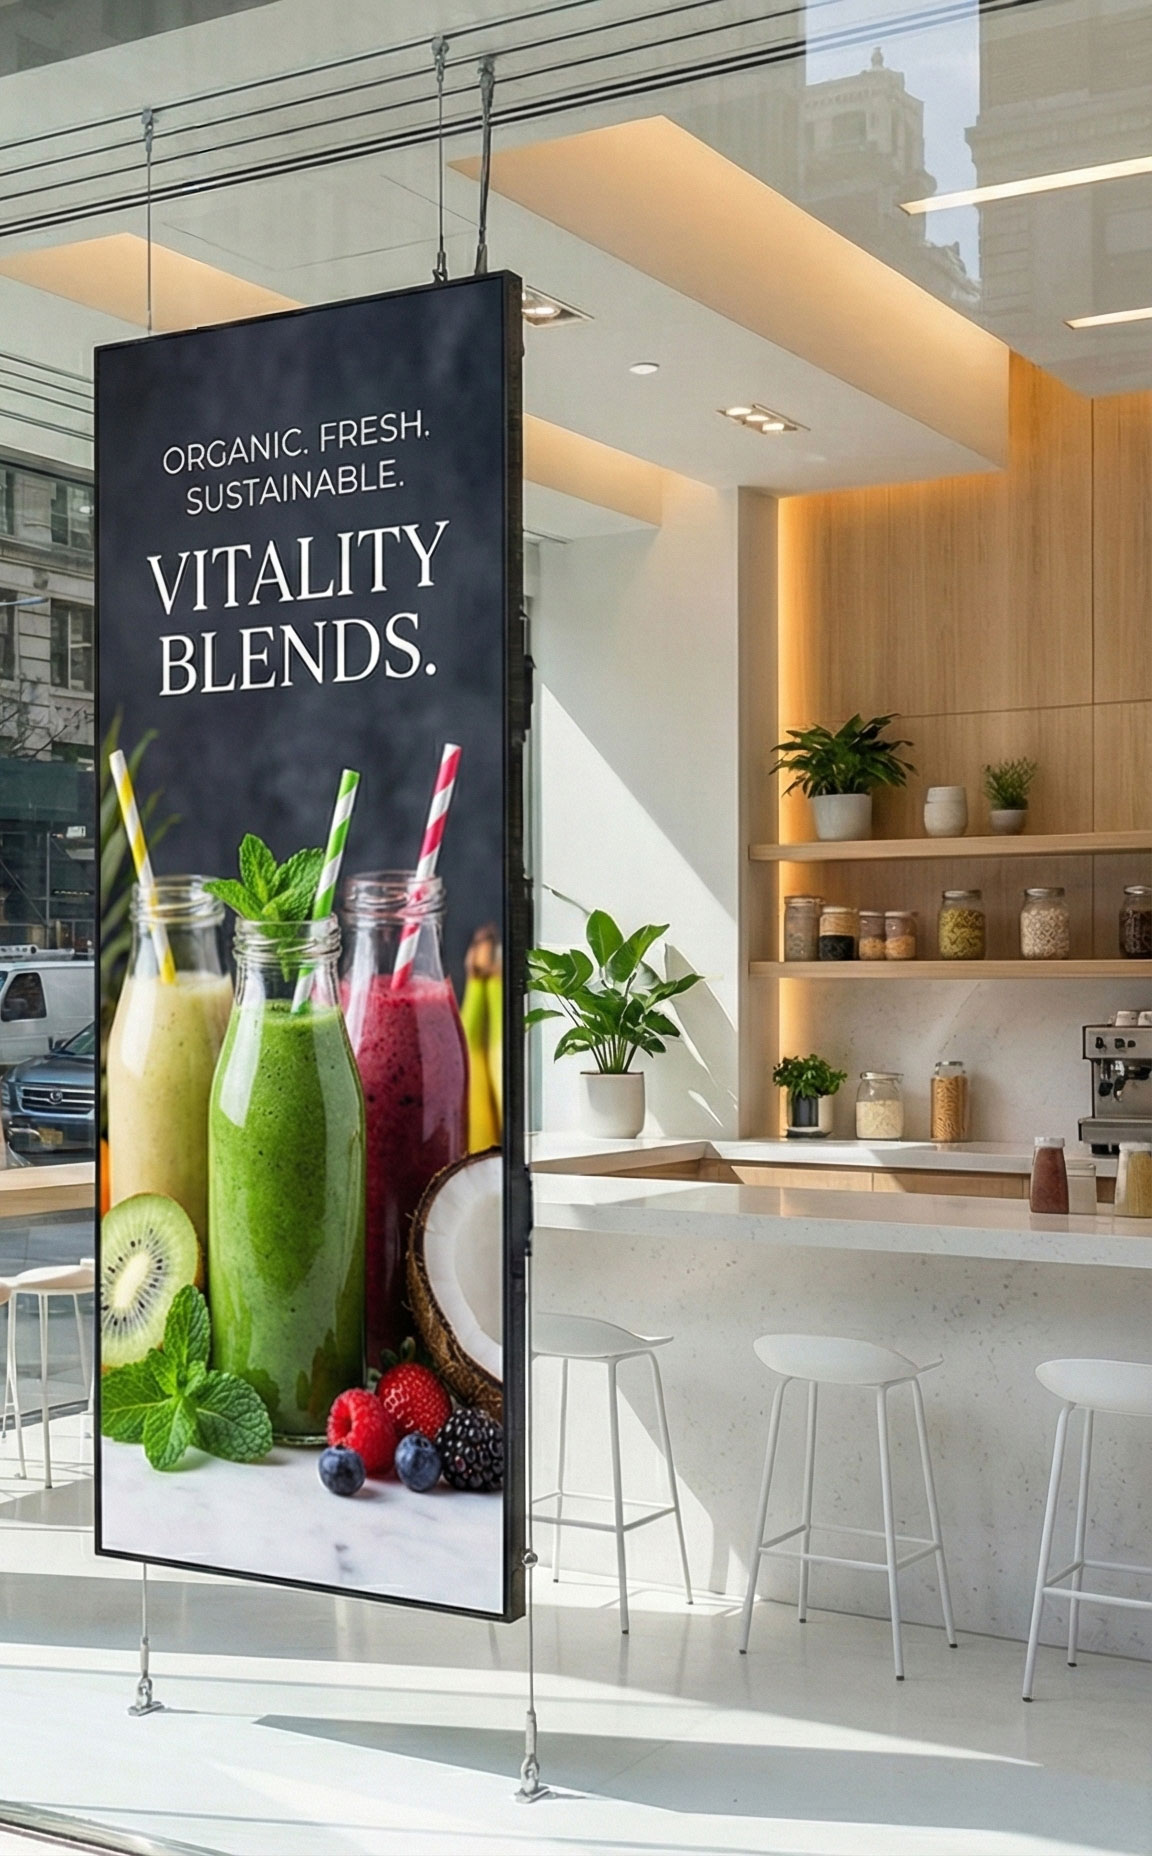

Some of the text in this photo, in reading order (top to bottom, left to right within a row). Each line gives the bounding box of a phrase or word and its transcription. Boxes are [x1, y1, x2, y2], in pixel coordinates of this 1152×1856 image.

[163, 409, 430, 475] ORGANIC. FRESH.
[186, 459, 404, 516] SUSTAINABLE.
[147, 520, 450, 616] VITALITY
[159, 612, 437, 697] BLENDS.
